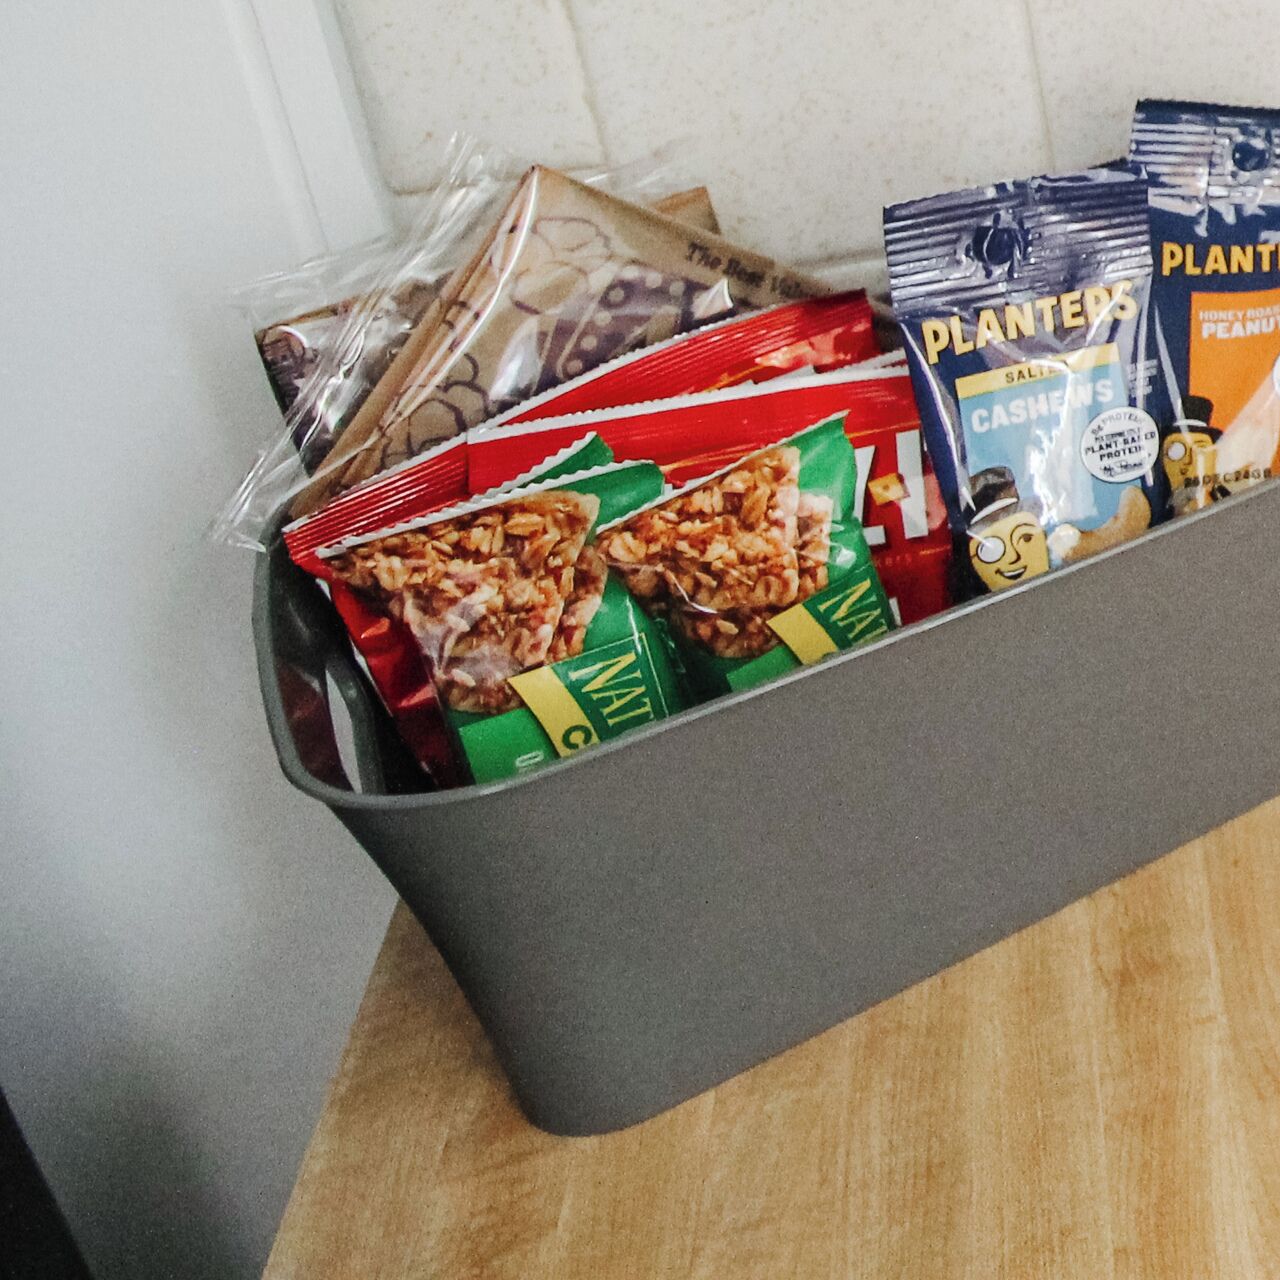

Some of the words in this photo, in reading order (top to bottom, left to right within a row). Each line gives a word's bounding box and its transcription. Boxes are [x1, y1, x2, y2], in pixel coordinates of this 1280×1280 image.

[921, 279, 1138, 365] PLANTERS
[1199, 307, 1243, 321] HONEY
[971, 379, 1115, 433] CASHEWS
